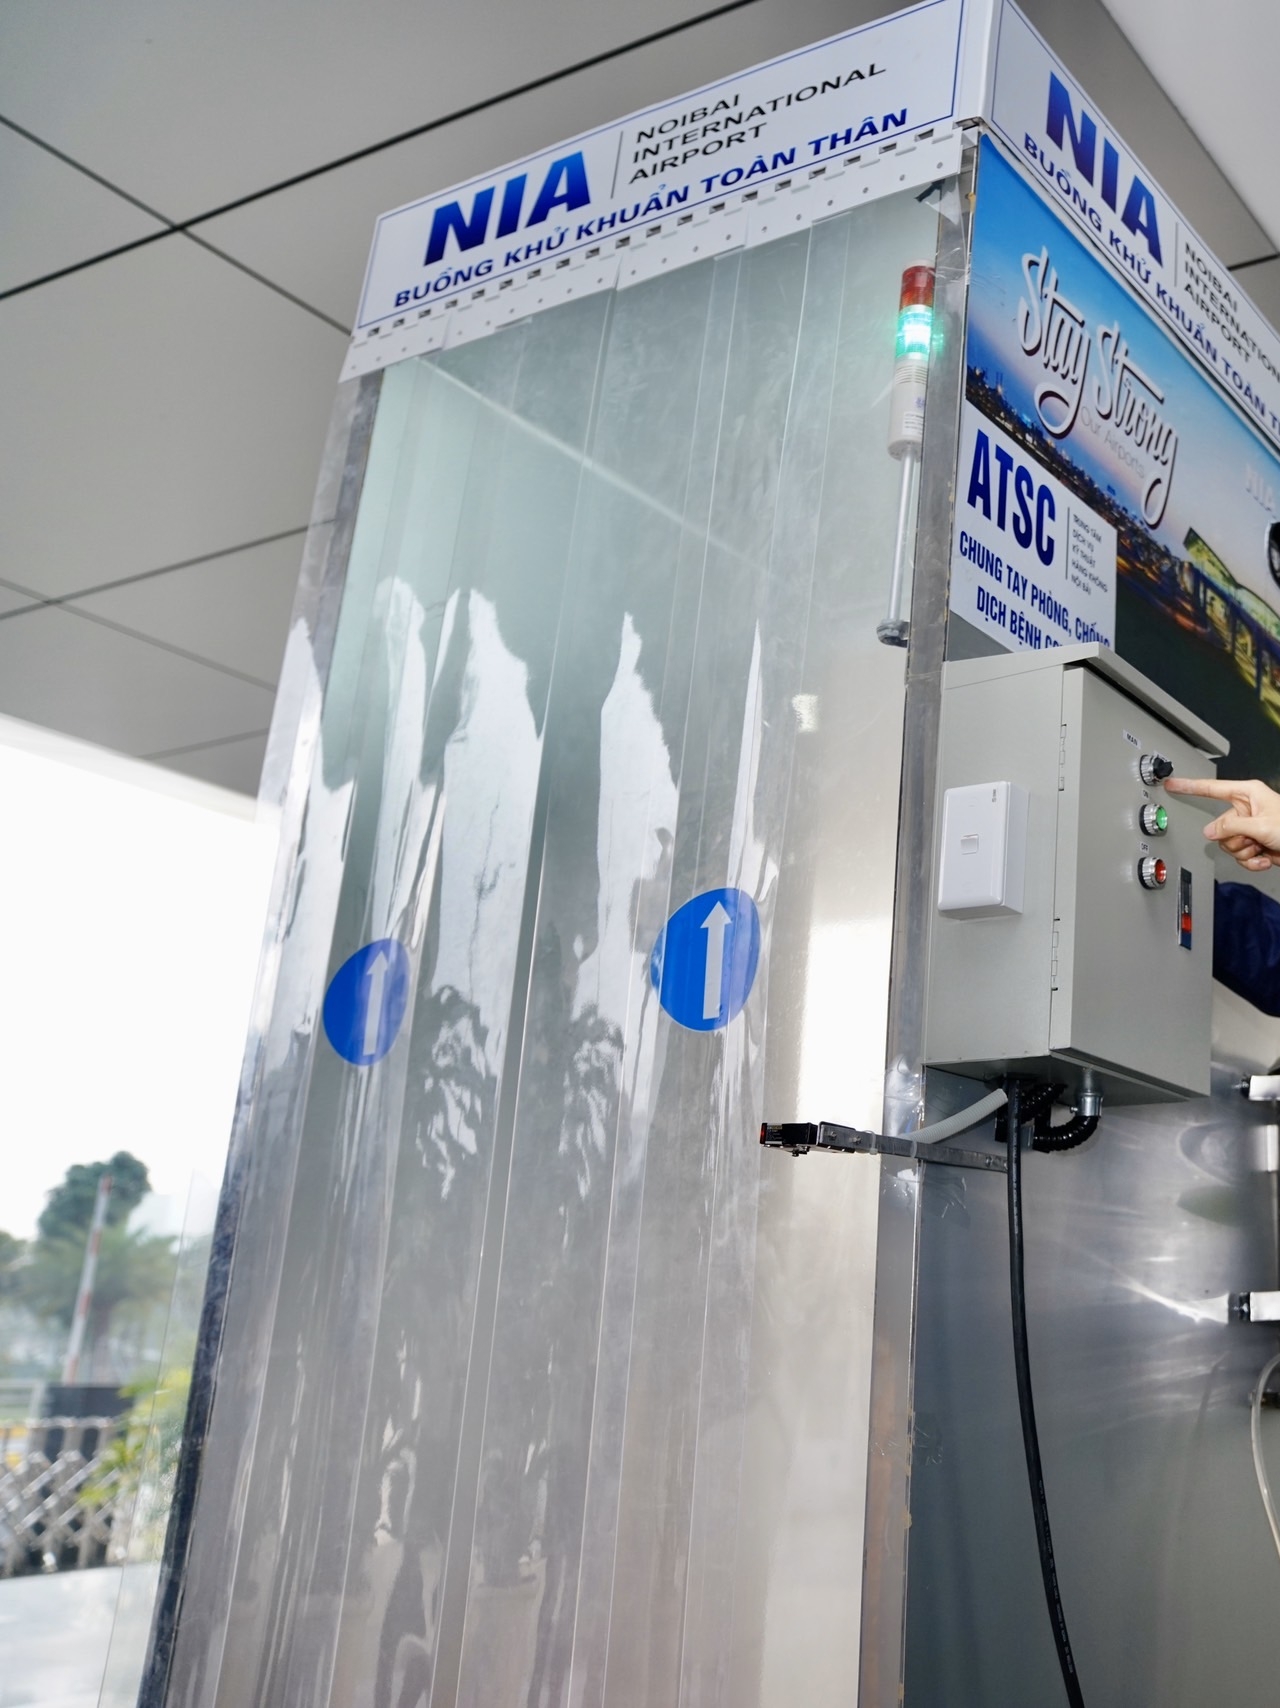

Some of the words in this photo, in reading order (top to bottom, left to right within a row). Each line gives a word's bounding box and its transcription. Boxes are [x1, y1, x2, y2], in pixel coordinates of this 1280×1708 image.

[628, 122, 767, 184] AIRPORT
[632, 63, 887, 164] INTERNATIONAL
[637, 93, 740, 143] NOIBAI
[394, 259, 494, 308] BUỒNG
[504, 226, 570, 268] KHỬ
[575, 183, 690, 241] KHUẨN
[700, 147, 796, 194] TOÀN
[808, 108, 908, 156] THÂN
[424, 150, 592, 267] NIA
[1046, 70, 1163, 269] NIA
[1024, 131, 1102, 233] BUỒNG
[1109, 229, 1151, 285] KHỬ
[1156, 283, 1218, 363] KHUẨN
[1221, 356, 1265, 416] TOÀN
[1184, 283, 1251, 363] AIRPORT
[1185, 242, 1238, 313] NOIBAI
[1017, 245, 1092, 440] Stay
[1093, 320, 1179, 531] Strong
[1081, 406, 1101, 435] Our
[1104, 430, 1144, 479] Airports
[967, 428, 1056, 567] ATSC
[959, 530, 1003, 583] CHUNG
[1006, 564, 1029, 601] TAY
[1030, 583, 1072, 637] PHÒNG,
[976, 585, 1007, 628] DỊCH
[1009, 609, 1042, 650] BỆNH
